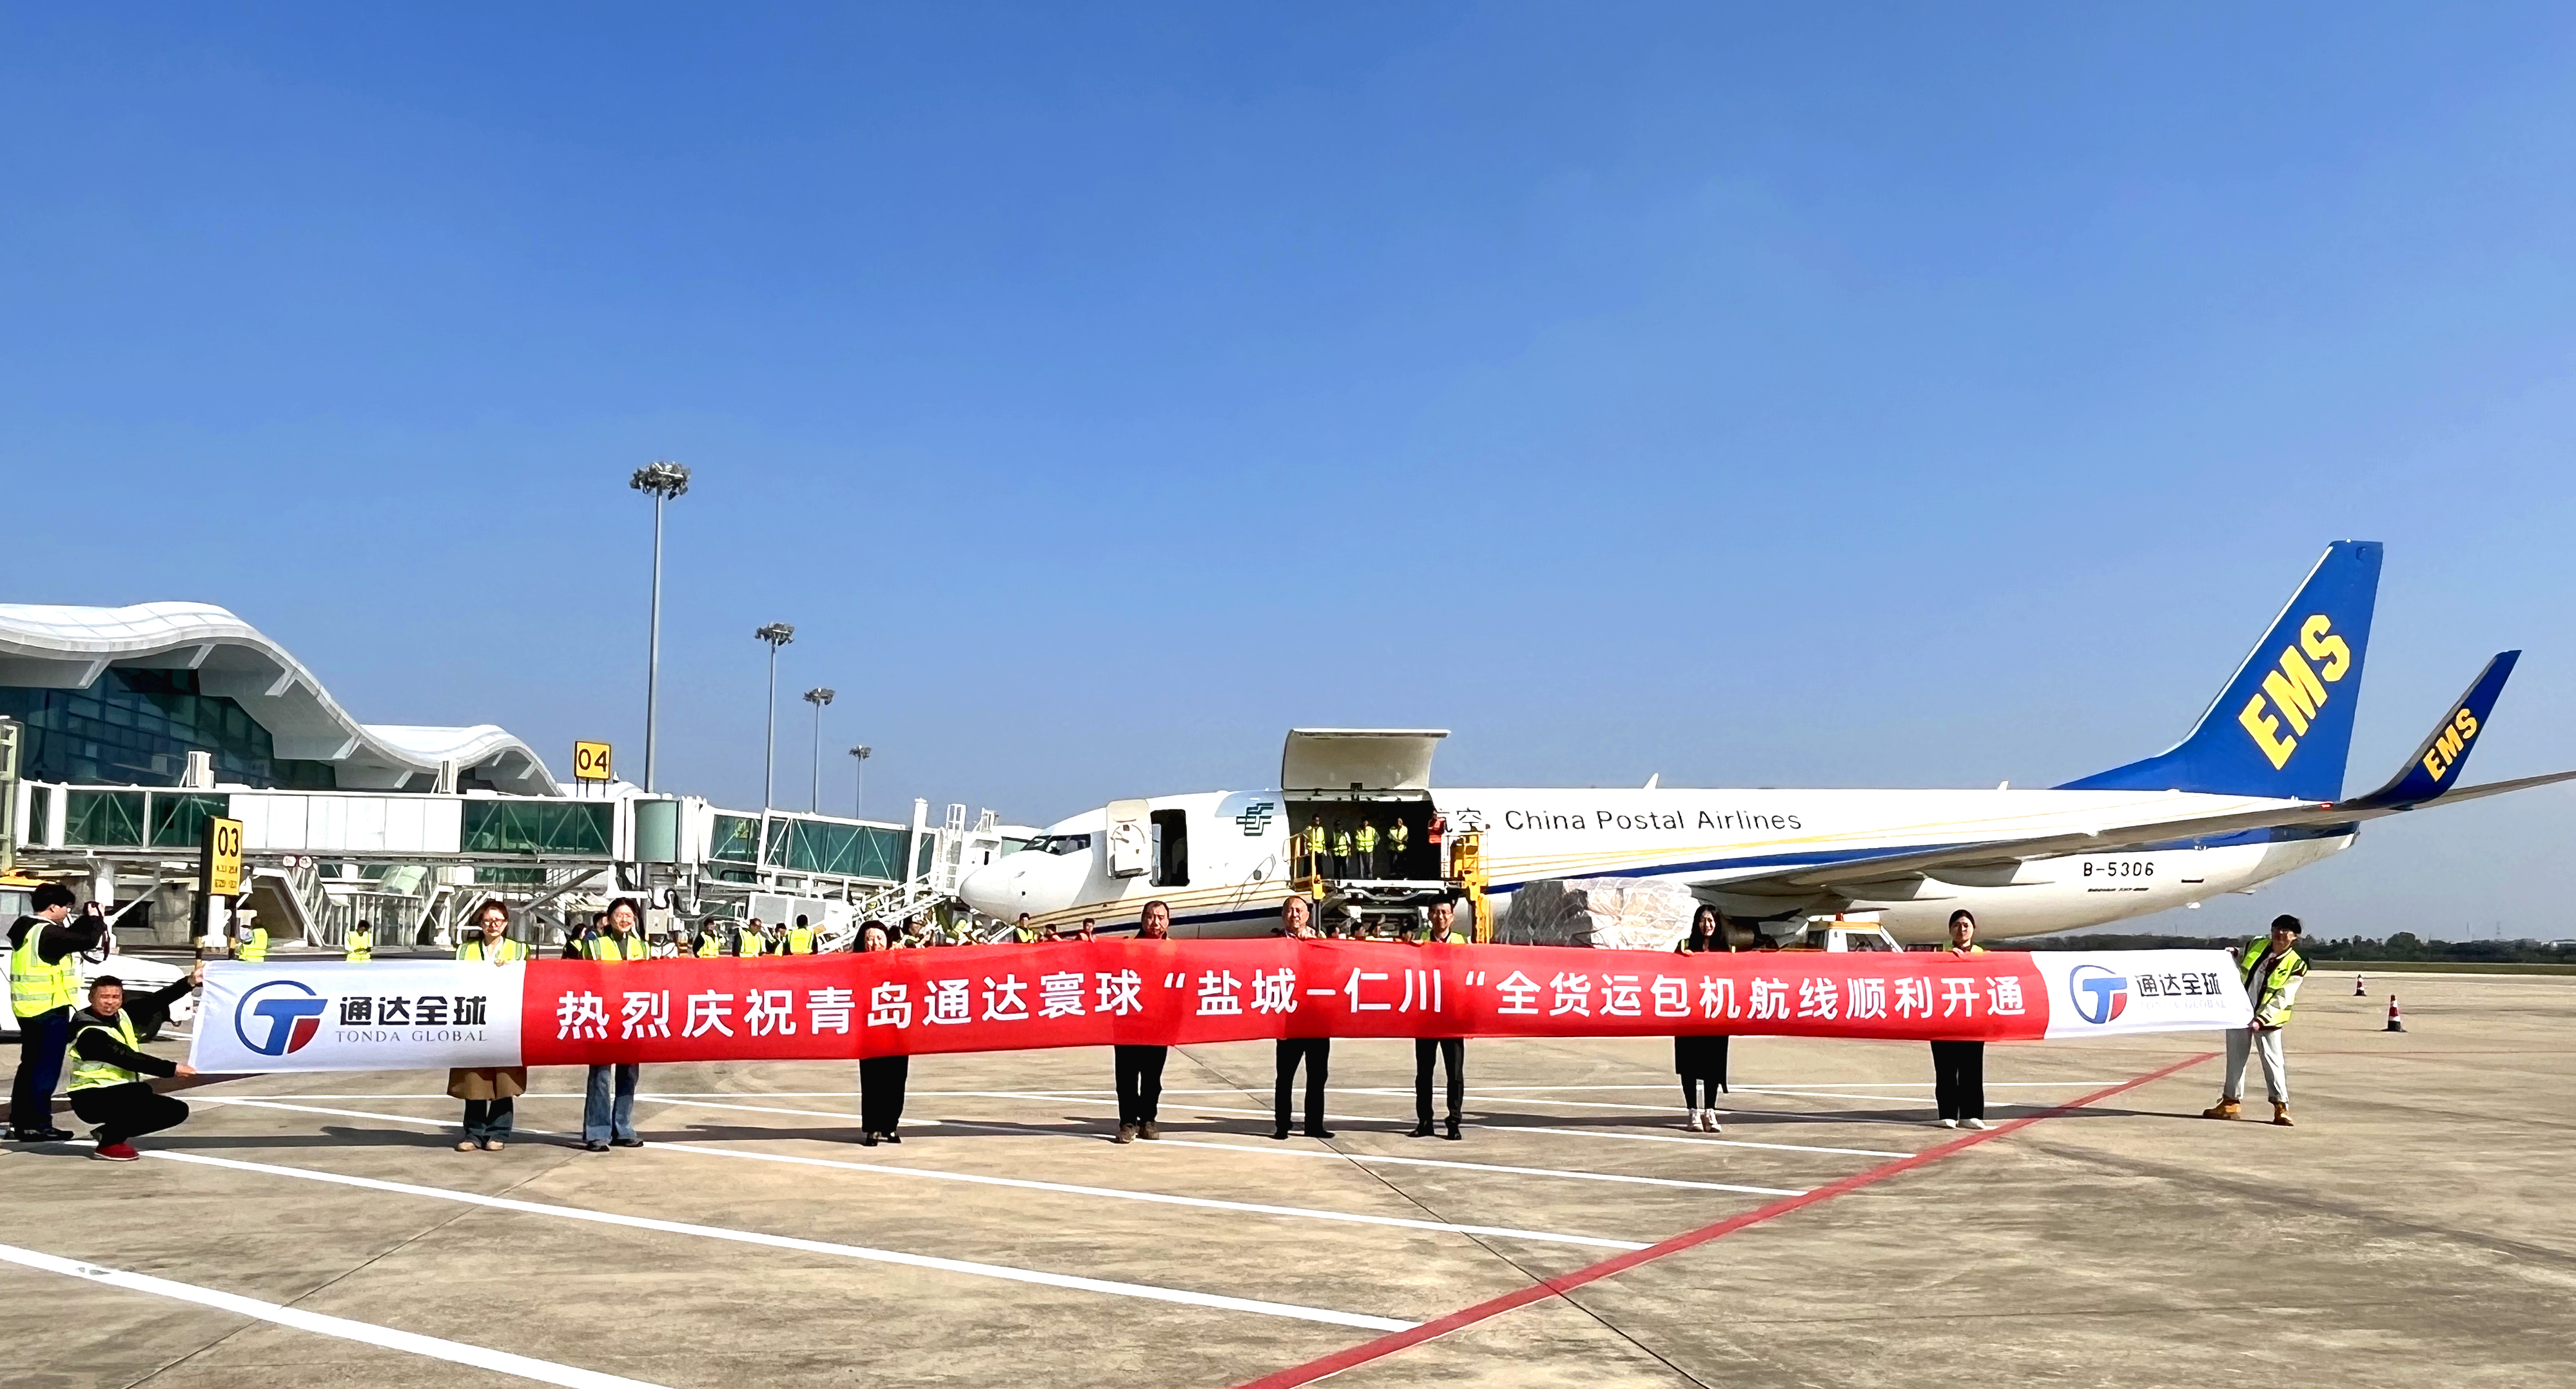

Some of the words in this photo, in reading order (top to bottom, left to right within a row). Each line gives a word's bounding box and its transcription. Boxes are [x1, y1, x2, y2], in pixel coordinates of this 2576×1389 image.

[2239, 615, 2350, 770] EMS
[2423, 708, 2477, 782] EMS
[578, 749, 607, 772] 04
[1506, 811, 1585, 830] China
[1596, 811, 1684, 829] Postal
[1698, 811, 1801, 829] Airlines
[218, 826, 239, 857] 03
[2083, 862, 2154, 876] B-5306
[2134, 972, 2222, 997] 通达全球
[339, 996, 487, 1025] 通达全球
[335, 1030, 400, 1042] TONDA
[412, 1030, 488, 1042] GLOBAL
